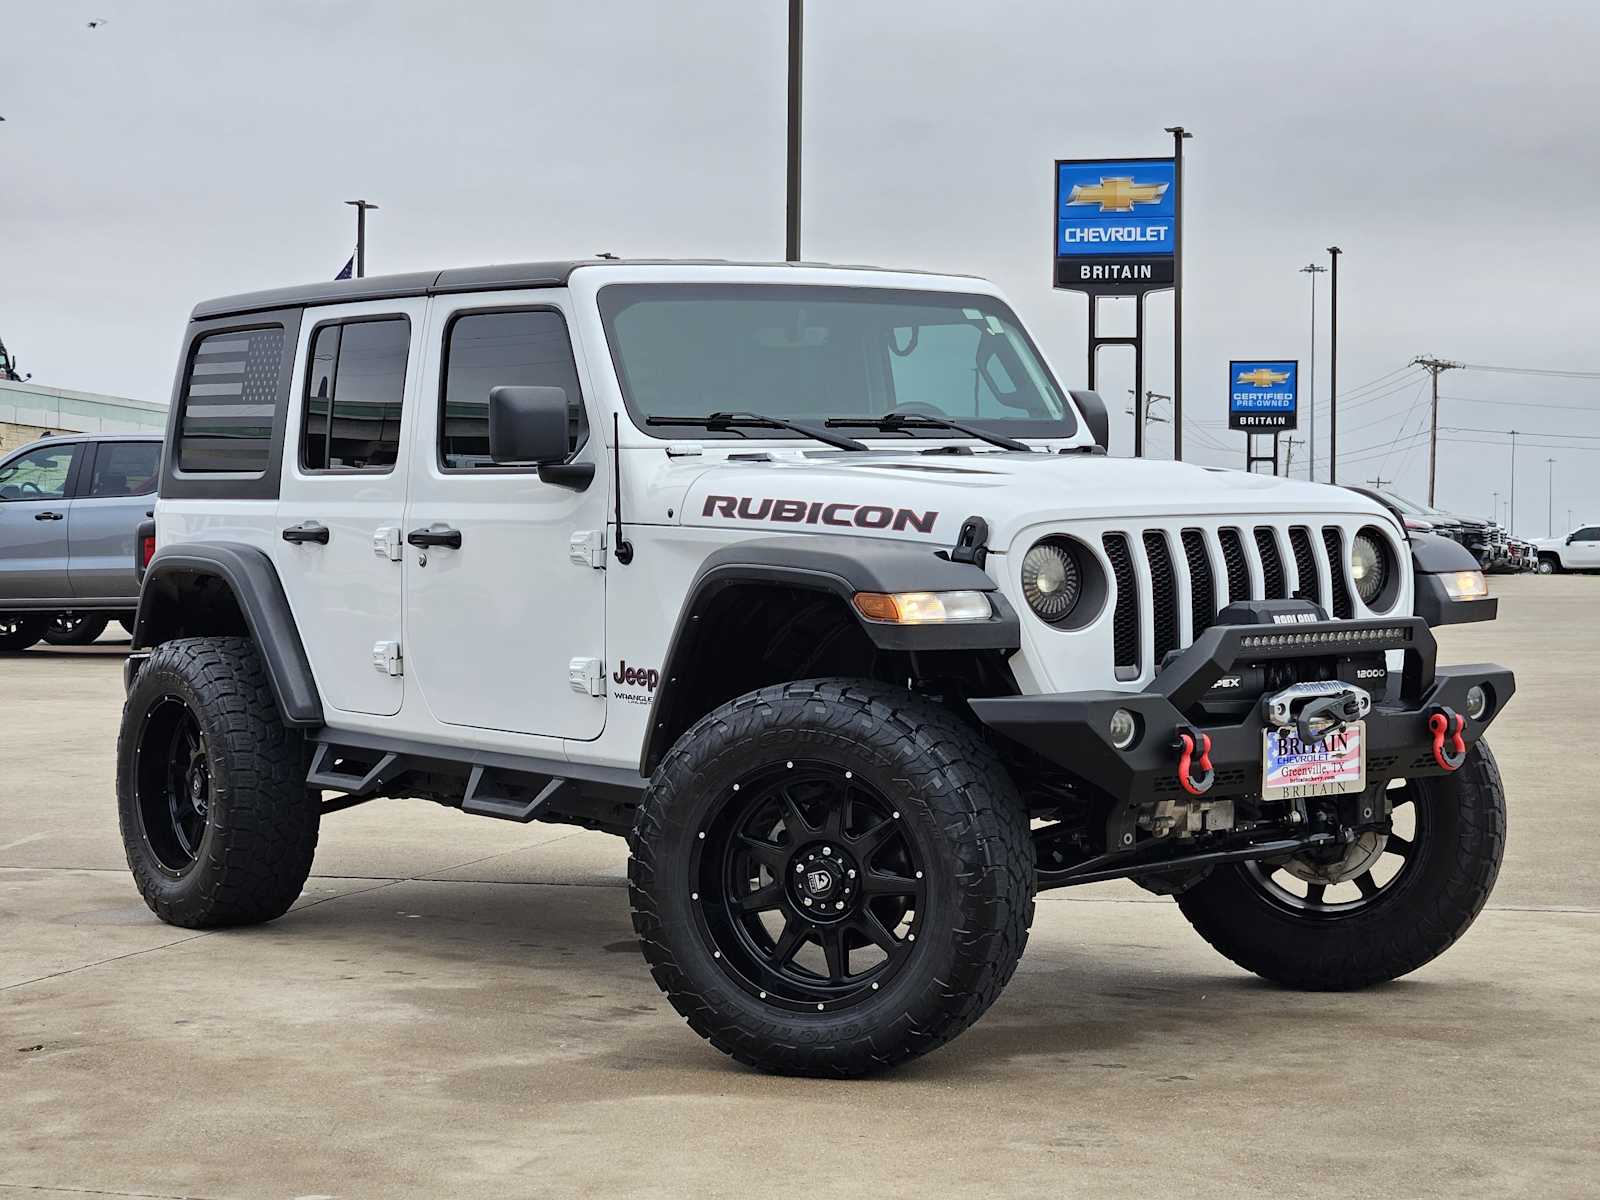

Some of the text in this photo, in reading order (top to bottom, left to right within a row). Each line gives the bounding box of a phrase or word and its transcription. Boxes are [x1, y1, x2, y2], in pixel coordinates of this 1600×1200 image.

[1064, 226, 1169, 243] CHEVROLET
[1080, 264, 1152, 280] BRITAIN
[1233, 392, 1293, 400] CERTIFIED
[1239, 416, 1286, 425] BRITAIN
[701, 495, 940, 534] RUBICON
[612, 659, 659, 692] Jeep
[1356, 669, 1385, 679] 12000
[1210, 678, 1241, 688] PEX
[614, 692, 655, 703] WRANGLE
[1277, 753, 1329, 765] CHEVROLET
[1281, 762, 1345, 777] Greenville, TX
[1282, 782, 1346, 798] BRITAIN
